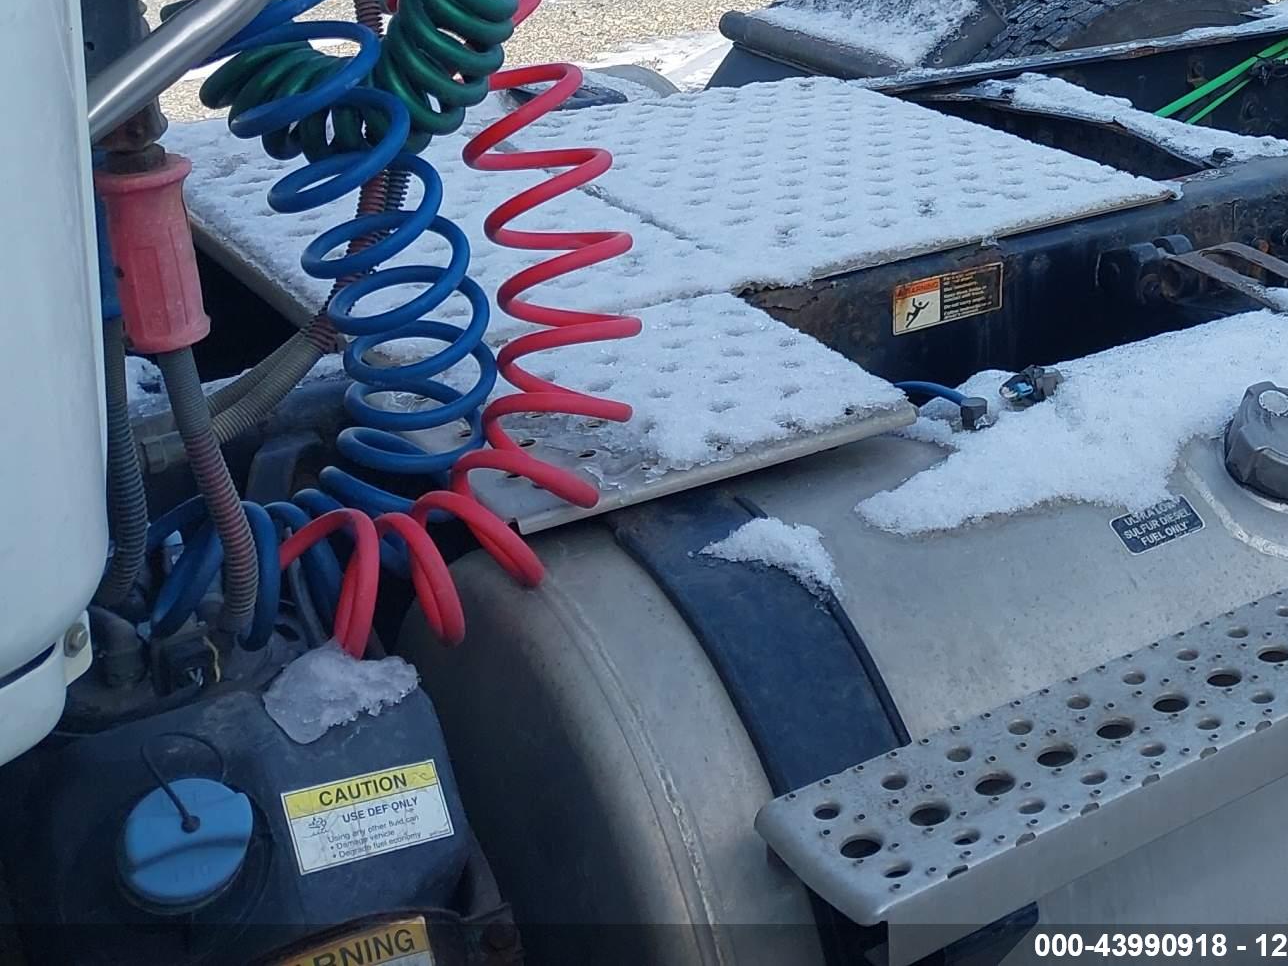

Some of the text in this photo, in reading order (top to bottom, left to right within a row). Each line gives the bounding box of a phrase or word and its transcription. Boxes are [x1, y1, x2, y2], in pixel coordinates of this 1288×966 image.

[1123, 508, 1192, 539] SULFUR DIESEL
[1141, 520, 1189, 546] FUEL ONLY
[319, 772, 408, 807] CAUTION
[342, 796, 419, 823] USE DEF ONLY
[327, 832, 351, 844] Using
[367, 822, 387, 833] other
[388, 817, 404, 827] fluid
[404, 814, 419, 824] can
[370, 830, 395, 840] vehicle
[373, 838, 388, 849] fuel
[388, 831, 421, 845] economy
